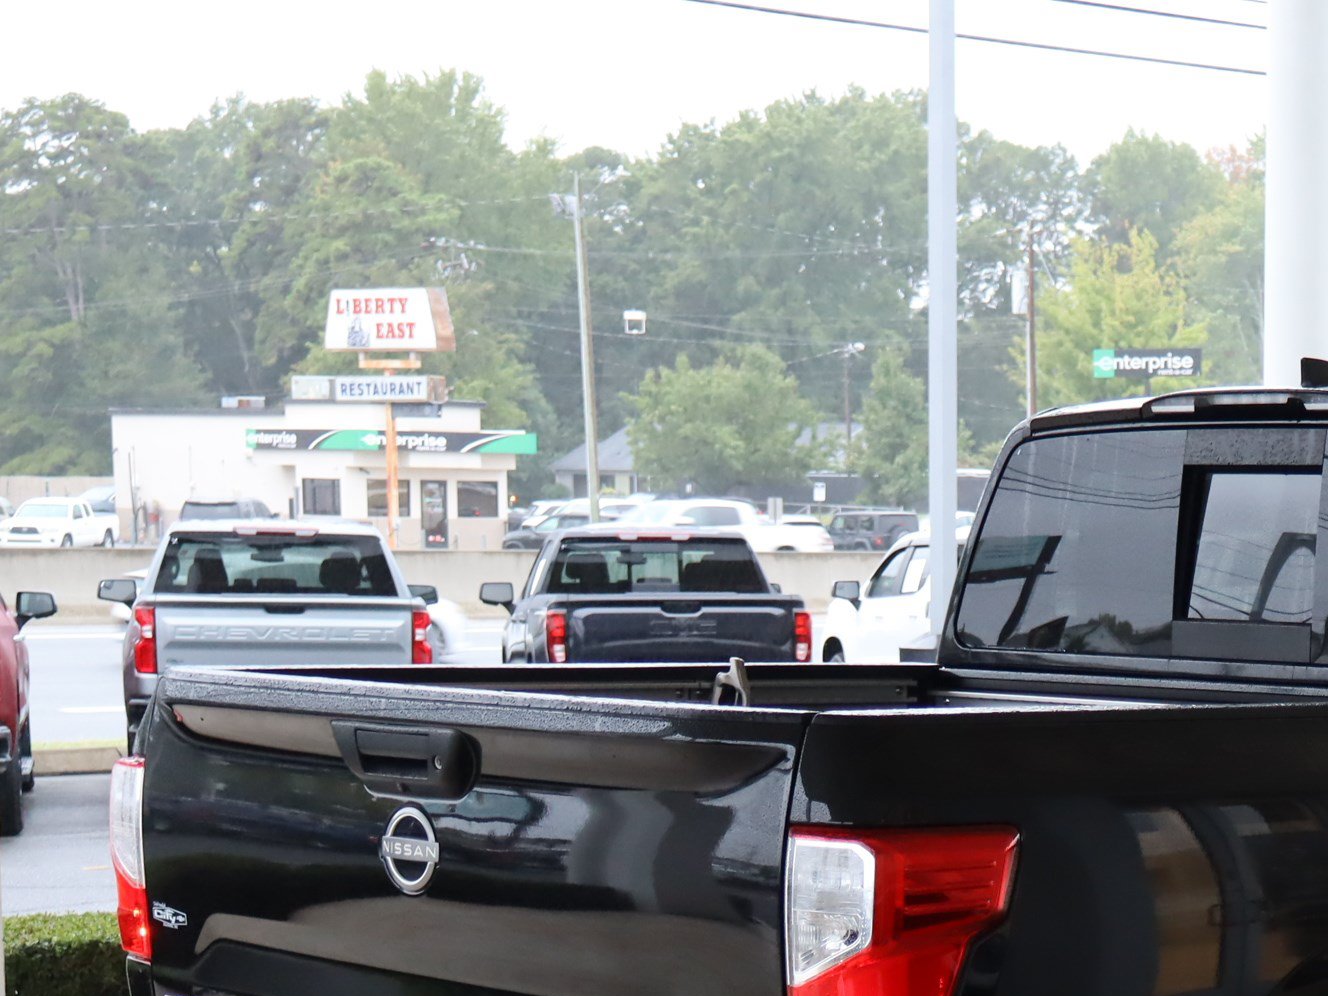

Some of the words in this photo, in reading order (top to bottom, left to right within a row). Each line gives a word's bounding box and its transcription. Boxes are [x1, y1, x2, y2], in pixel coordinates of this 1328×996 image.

[375, 321, 417, 339] EAST
[1098, 352, 1194, 373] enterprise
[340, 381, 423, 397] RESTAURANT
[362, 432, 447, 450] enerprise
[174, 625, 396, 642] CHEVROLET
[383, 840, 438, 859] NISSAN
